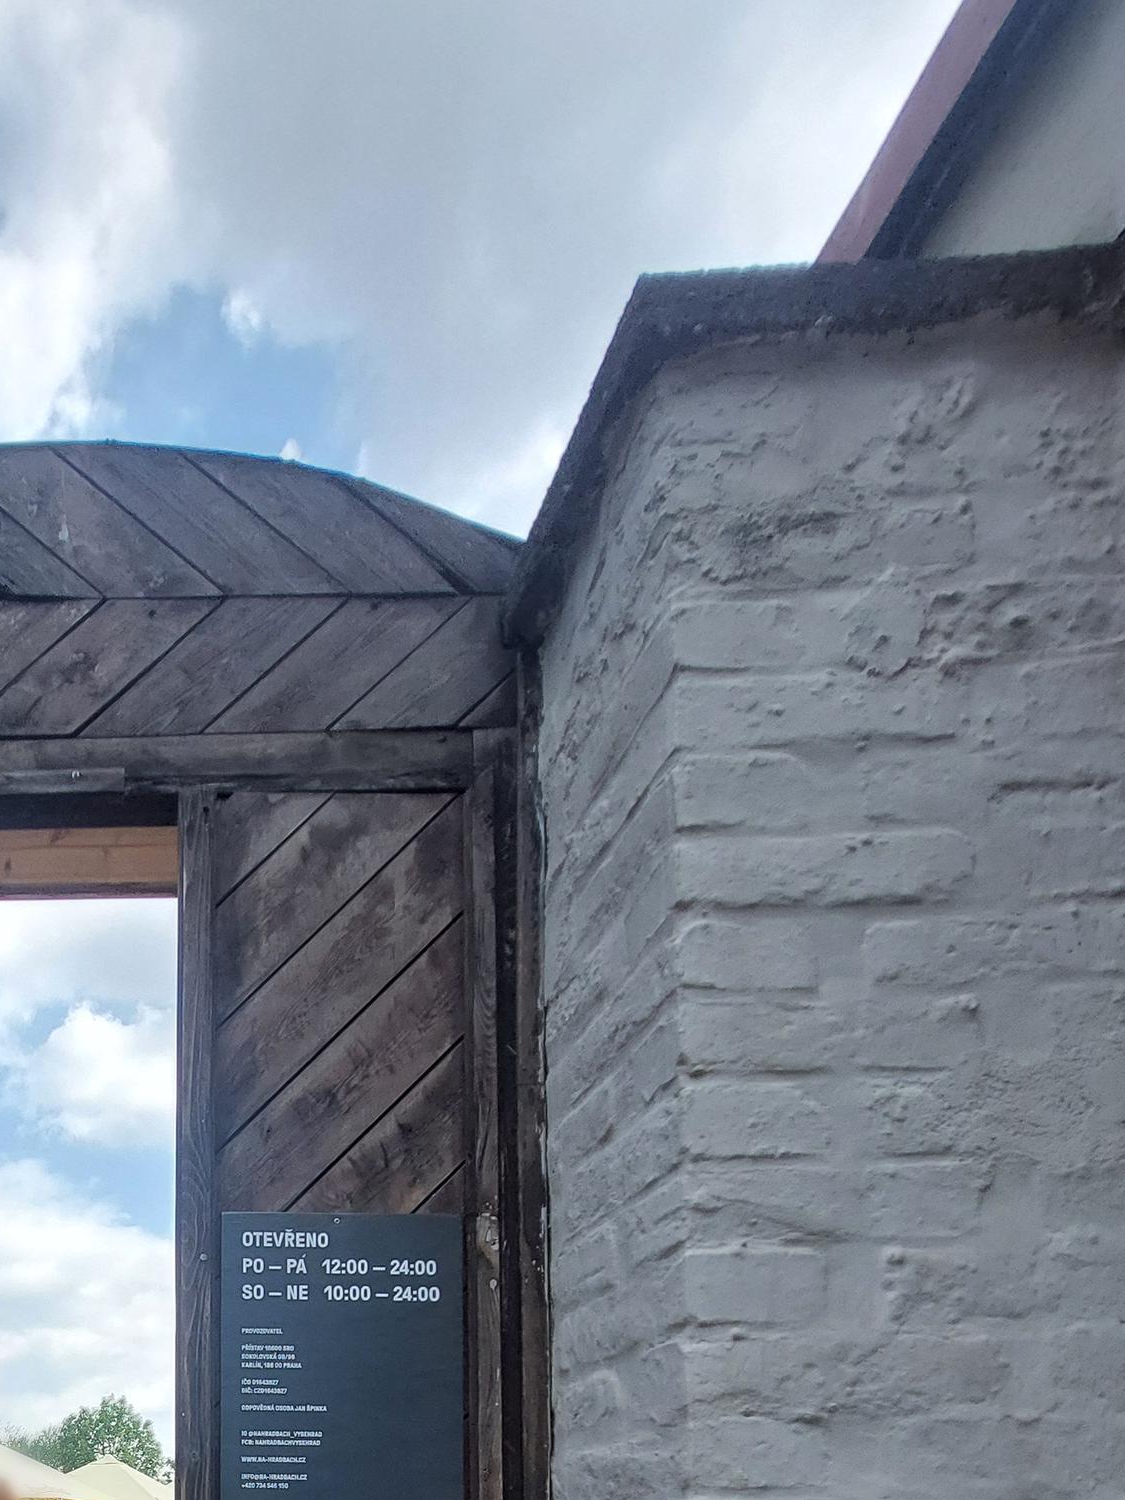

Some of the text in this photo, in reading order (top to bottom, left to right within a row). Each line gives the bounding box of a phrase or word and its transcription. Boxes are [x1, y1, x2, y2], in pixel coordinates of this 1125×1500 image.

[242, 1228, 329, 1248] OTEVŘENO
[242, 1257, 265, 1274] PO
[286, 1253, 308, 1274] PÁ
[321, 1258, 369, 1275] 12:00
[389, 1259, 438, 1276] 24:00
[242, 1284, 265, 1301] SO
[286, 1284, 309, 1301] NE
[323, 1285, 372, 1302] 10:00
[392, 1286, 441, 1303] 24:00
